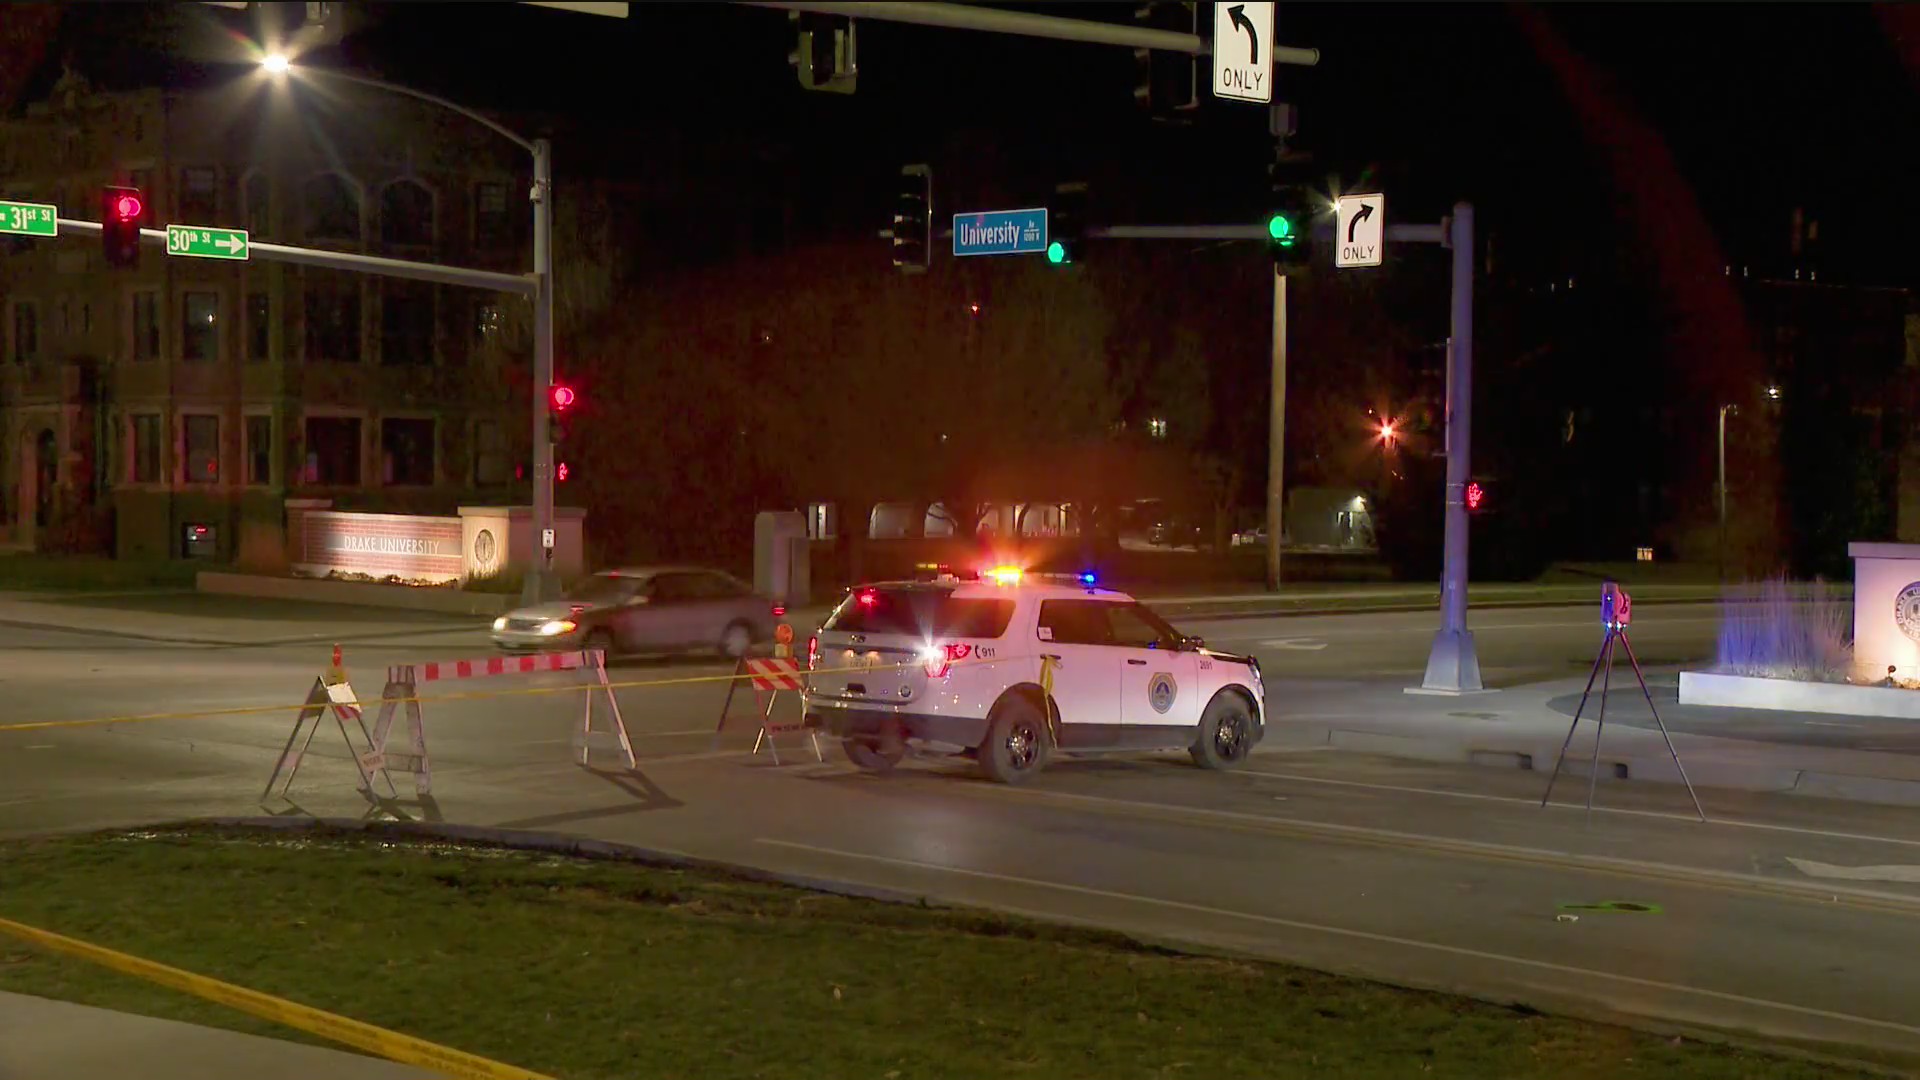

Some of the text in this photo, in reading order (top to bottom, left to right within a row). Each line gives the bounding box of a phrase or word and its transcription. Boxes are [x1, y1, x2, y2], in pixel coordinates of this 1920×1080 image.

[1223, 68, 1263, 91] ONLY
[10, 206, 51, 230] 31st St
[170, 230, 211, 251] 30th St
[960, 220, 1020, 249] University
[1343, 245, 1375, 261] ONLY
[344, 536, 440, 554] DRAKE UNIVERSITY
[981, 647, 996, 659] 911
